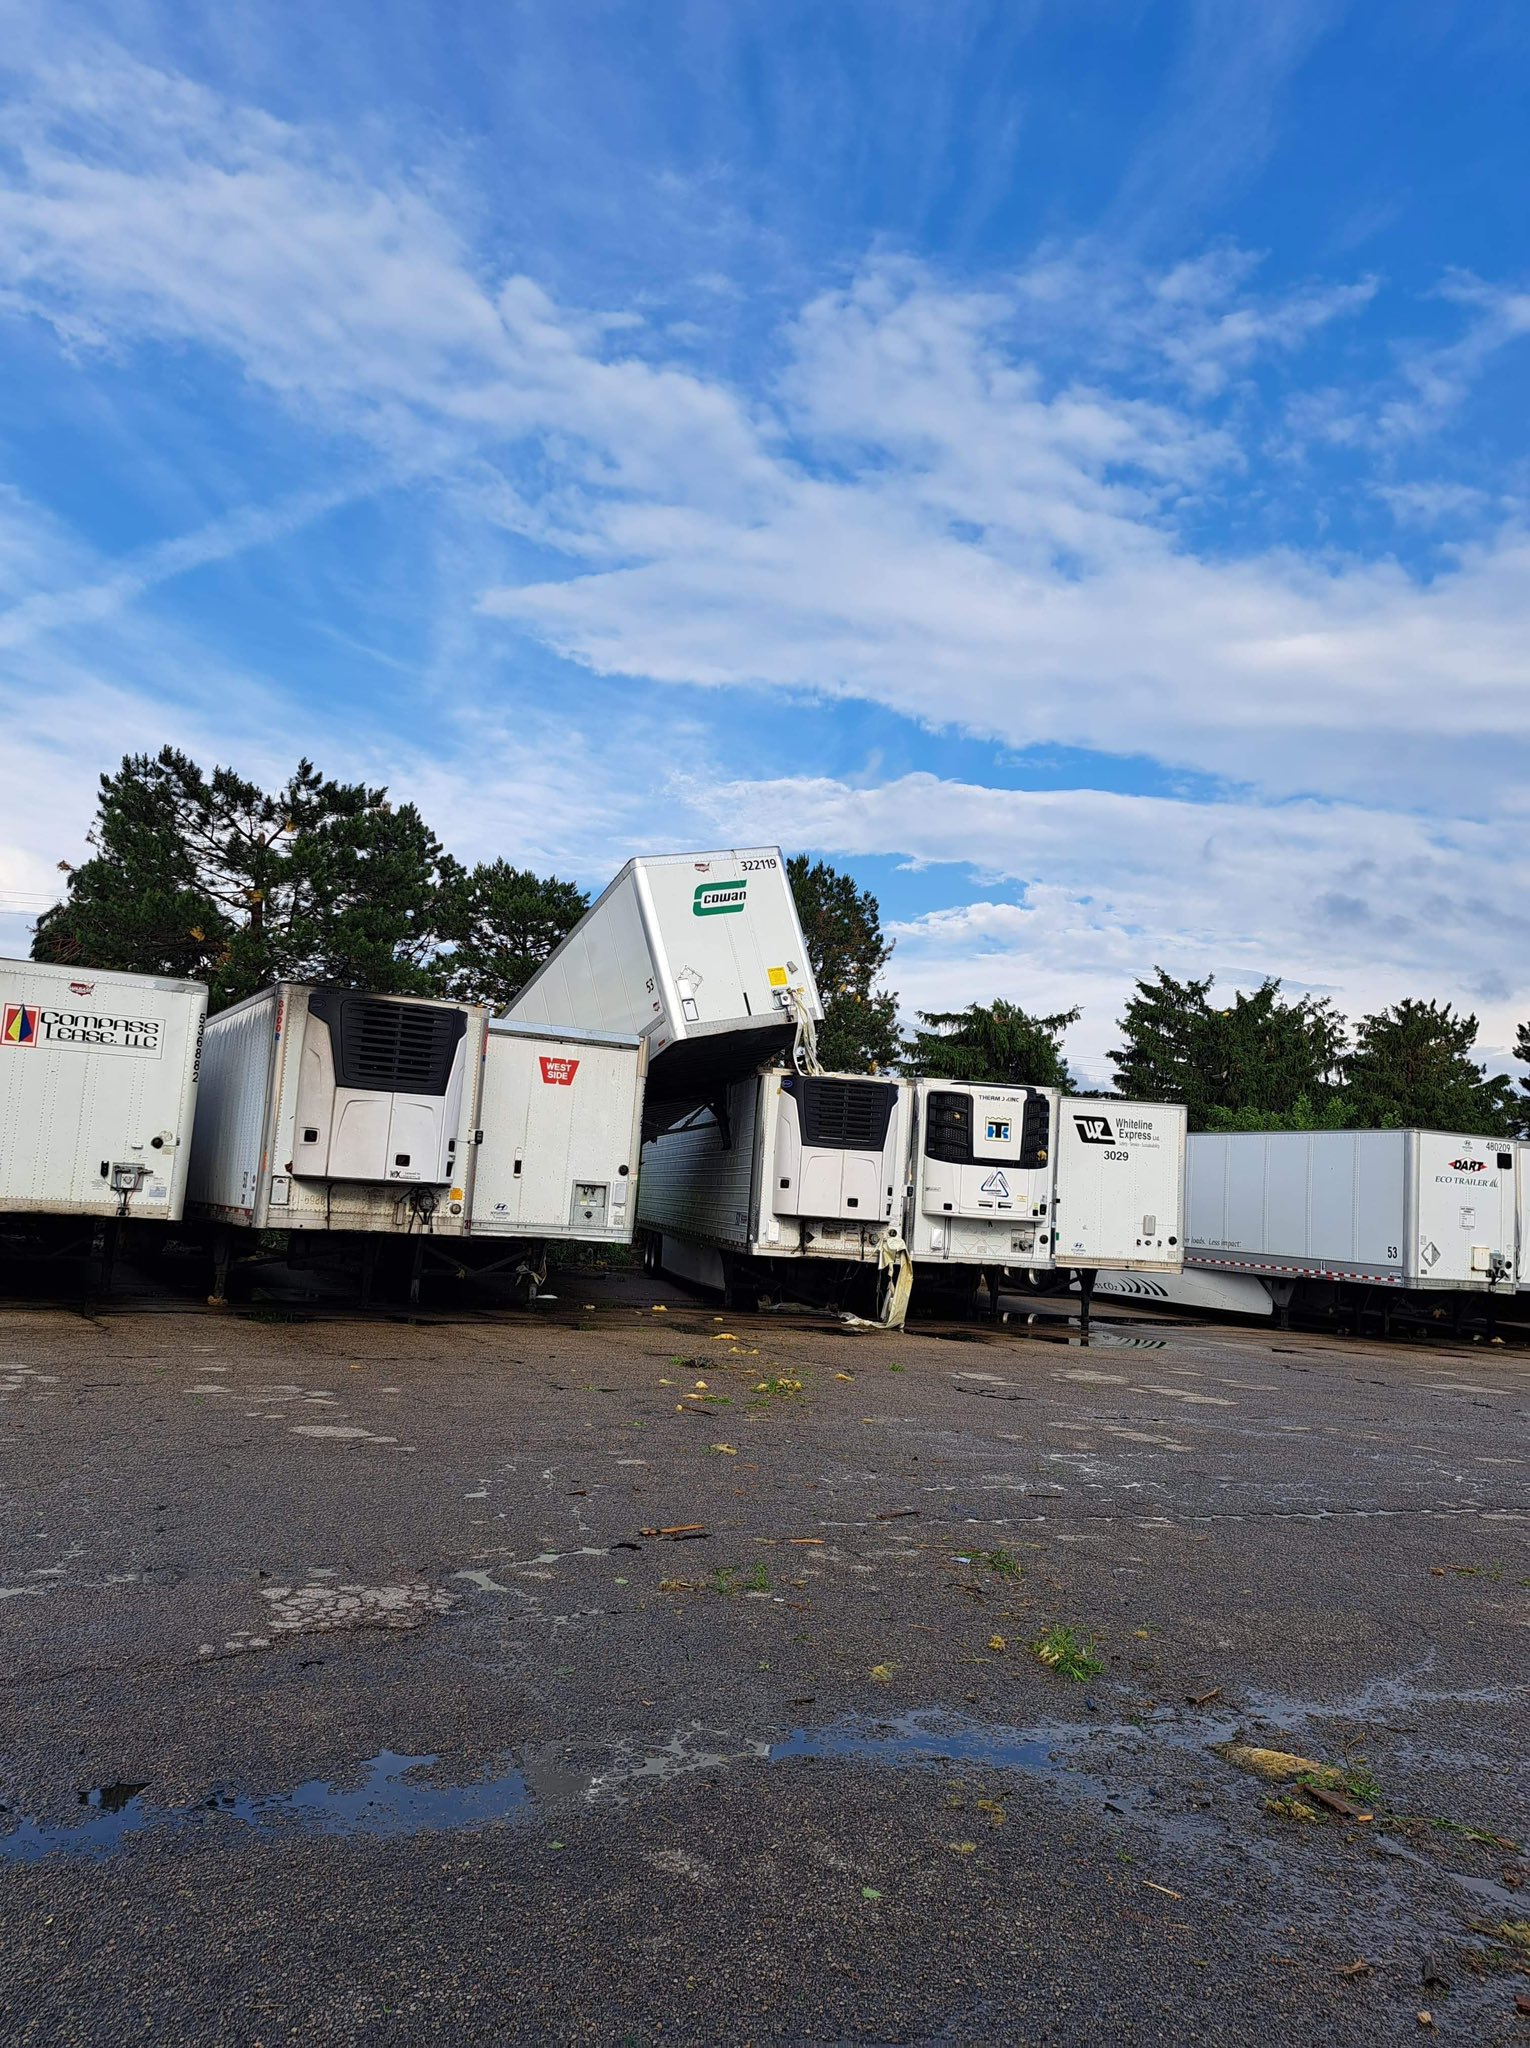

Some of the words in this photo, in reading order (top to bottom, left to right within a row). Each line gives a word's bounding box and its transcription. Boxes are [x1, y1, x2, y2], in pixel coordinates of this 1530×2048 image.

[740, 858, 777, 872] 322119
[192, 1012, 207, 1083] 536882
[546, 1062, 572, 1072] WEST
[547, 1070, 569, 1080] SIDE
[1115, 1117, 1153, 1131] Whiteline
[1118, 1128, 1152, 1141] Express
[1485, 1141, 1511, 1153] 480209
[1103, 1150, 1129, 1162] 3029
[1453, 1159, 1484, 1172] DART
[1435, 1175, 1453, 1184] ECO
[1454, 1177, 1488, 1188] TRAILER
[1209, 1237, 1220, 1246] Less
[1387, 1246, 1398, 1259] 53
